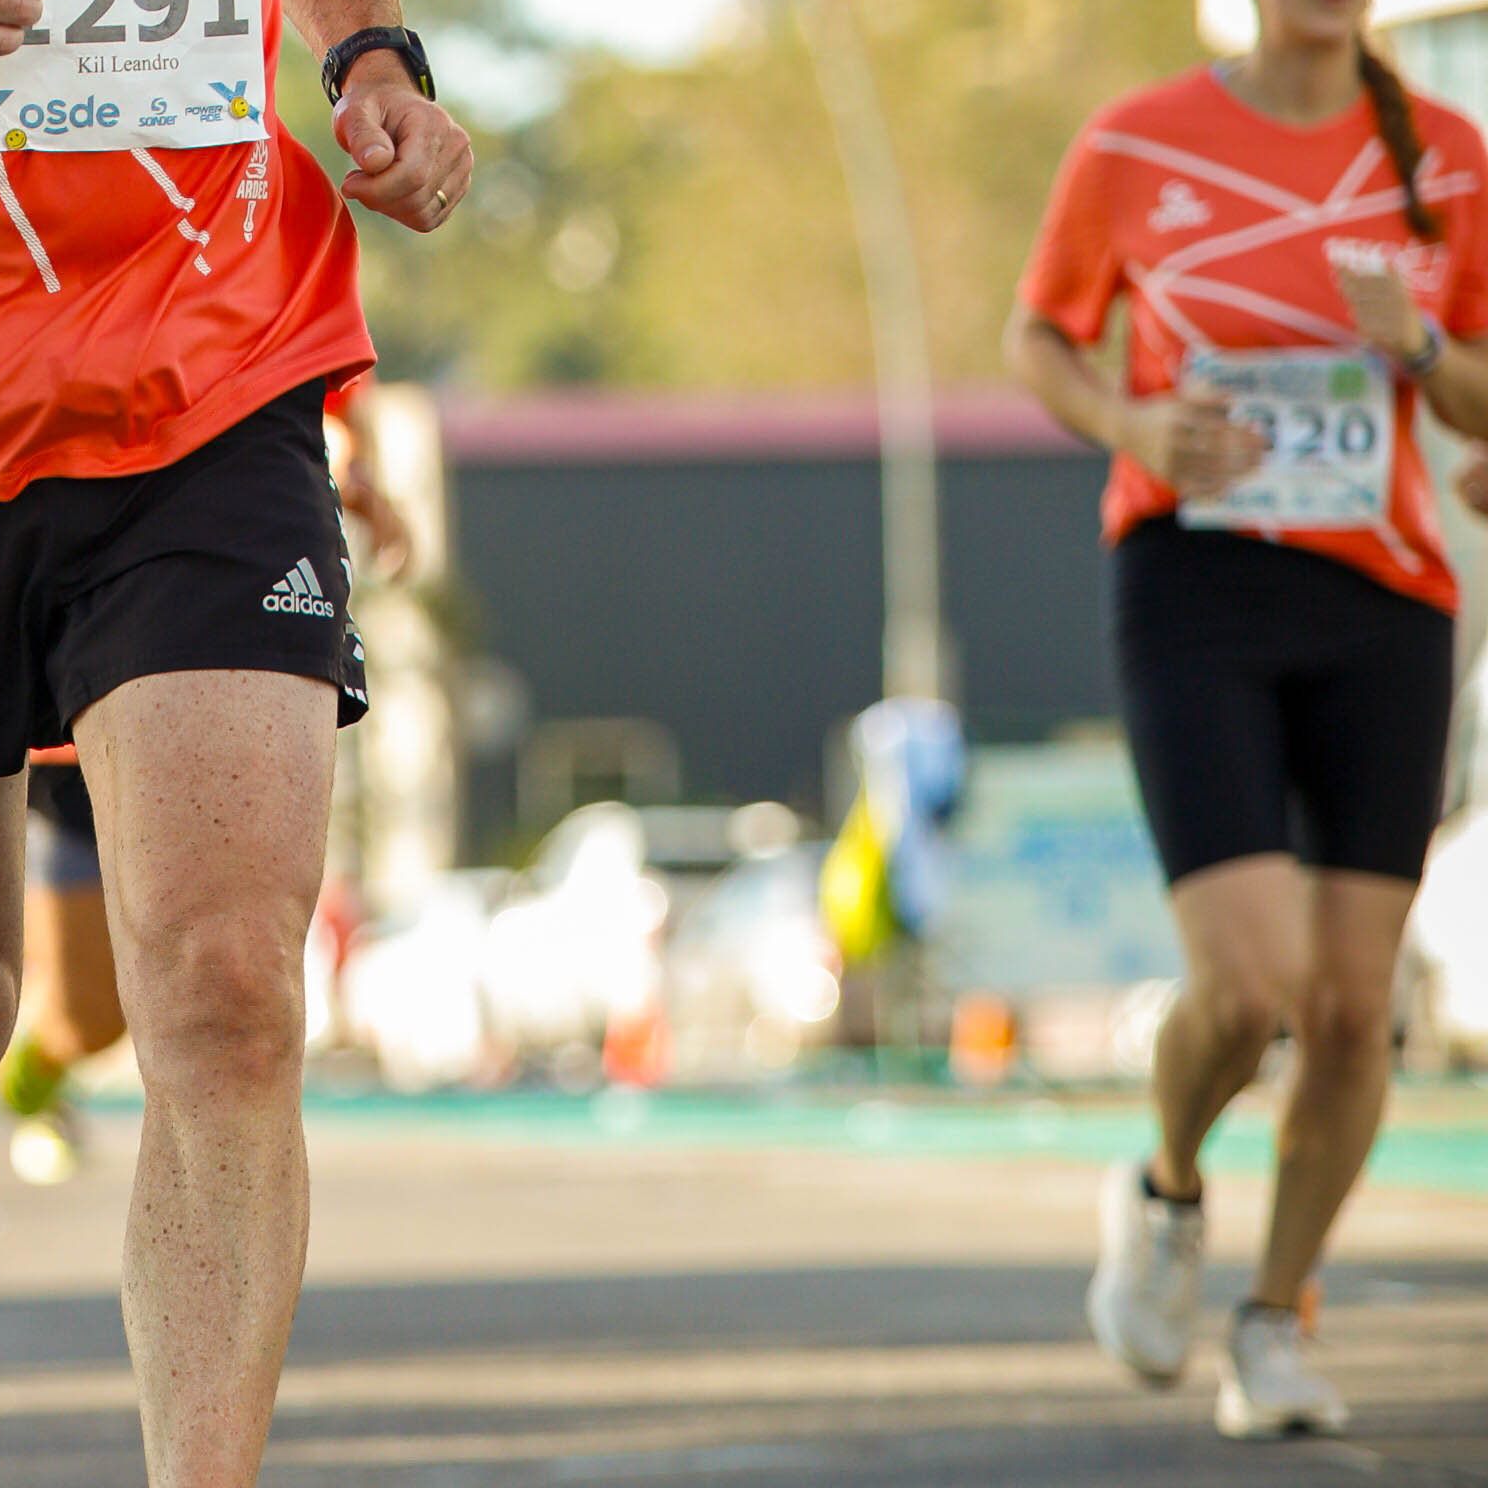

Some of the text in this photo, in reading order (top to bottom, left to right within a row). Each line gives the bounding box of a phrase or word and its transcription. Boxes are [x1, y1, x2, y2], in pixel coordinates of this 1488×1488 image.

[77, 53, 180, 74] Kil Leandro
[19, 94, 121, 129] osde
[184, 104, 224, 117] POWER
[262, 591, 335, 618] adidas
